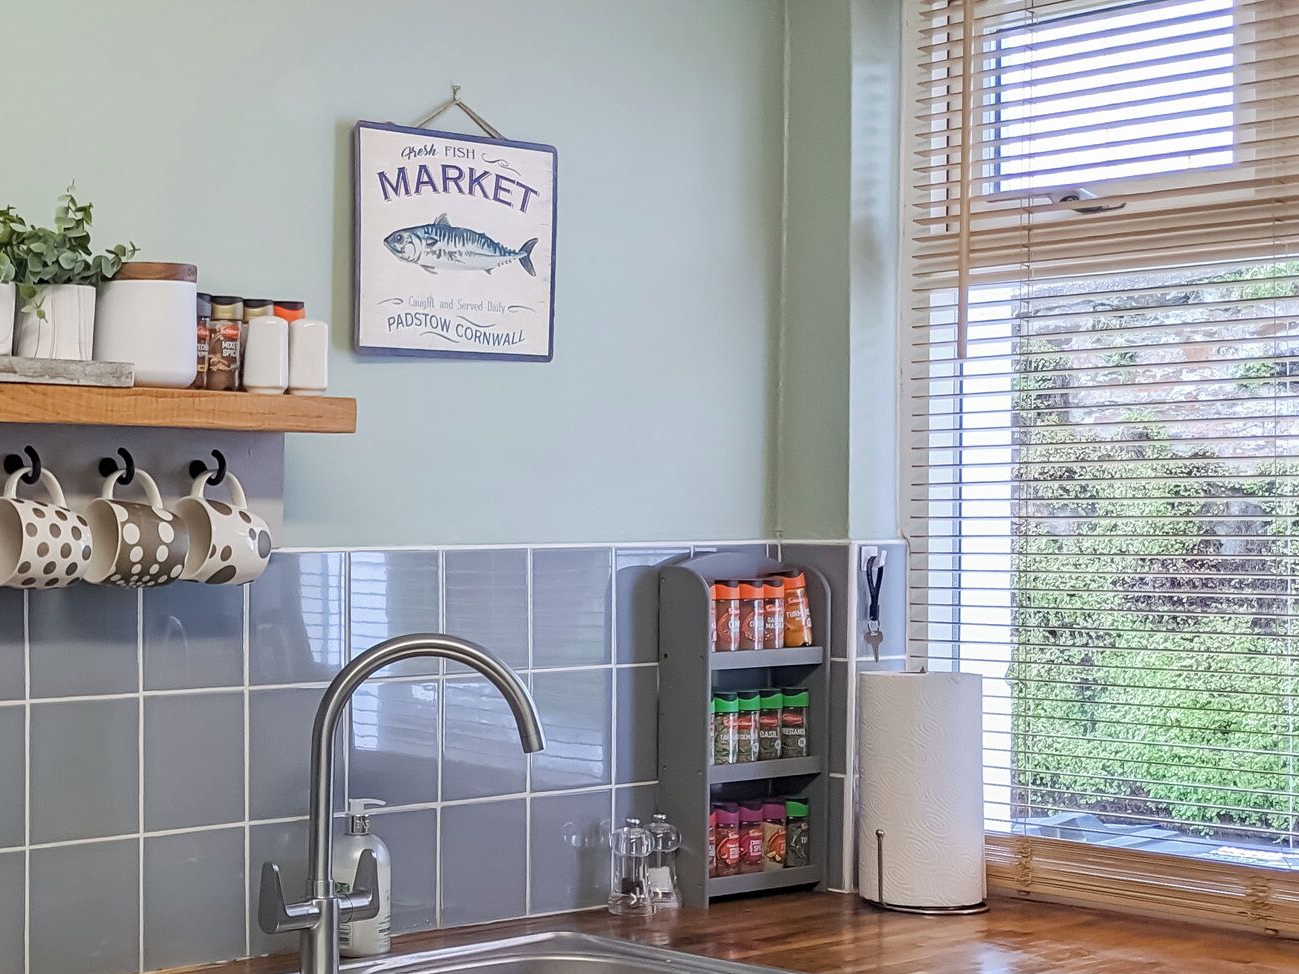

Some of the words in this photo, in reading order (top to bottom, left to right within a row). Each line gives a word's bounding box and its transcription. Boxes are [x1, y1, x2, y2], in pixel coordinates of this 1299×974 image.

[401, 144, 439, 160] Fresh
[445, 146, 475, 160] FISH
[377, 164, 541, 214] MARKET
[408, 296, 435, 308] Caught
[439, 299, 454, 310] and
[457, 299, 483, 312] Served
[487, 301, 506, 314] Daily
[387, 312, 451, 332] PADSTOW
[455, 324, 526, 346] CORNWALL
[760, 730, 778, 738] BASIL
